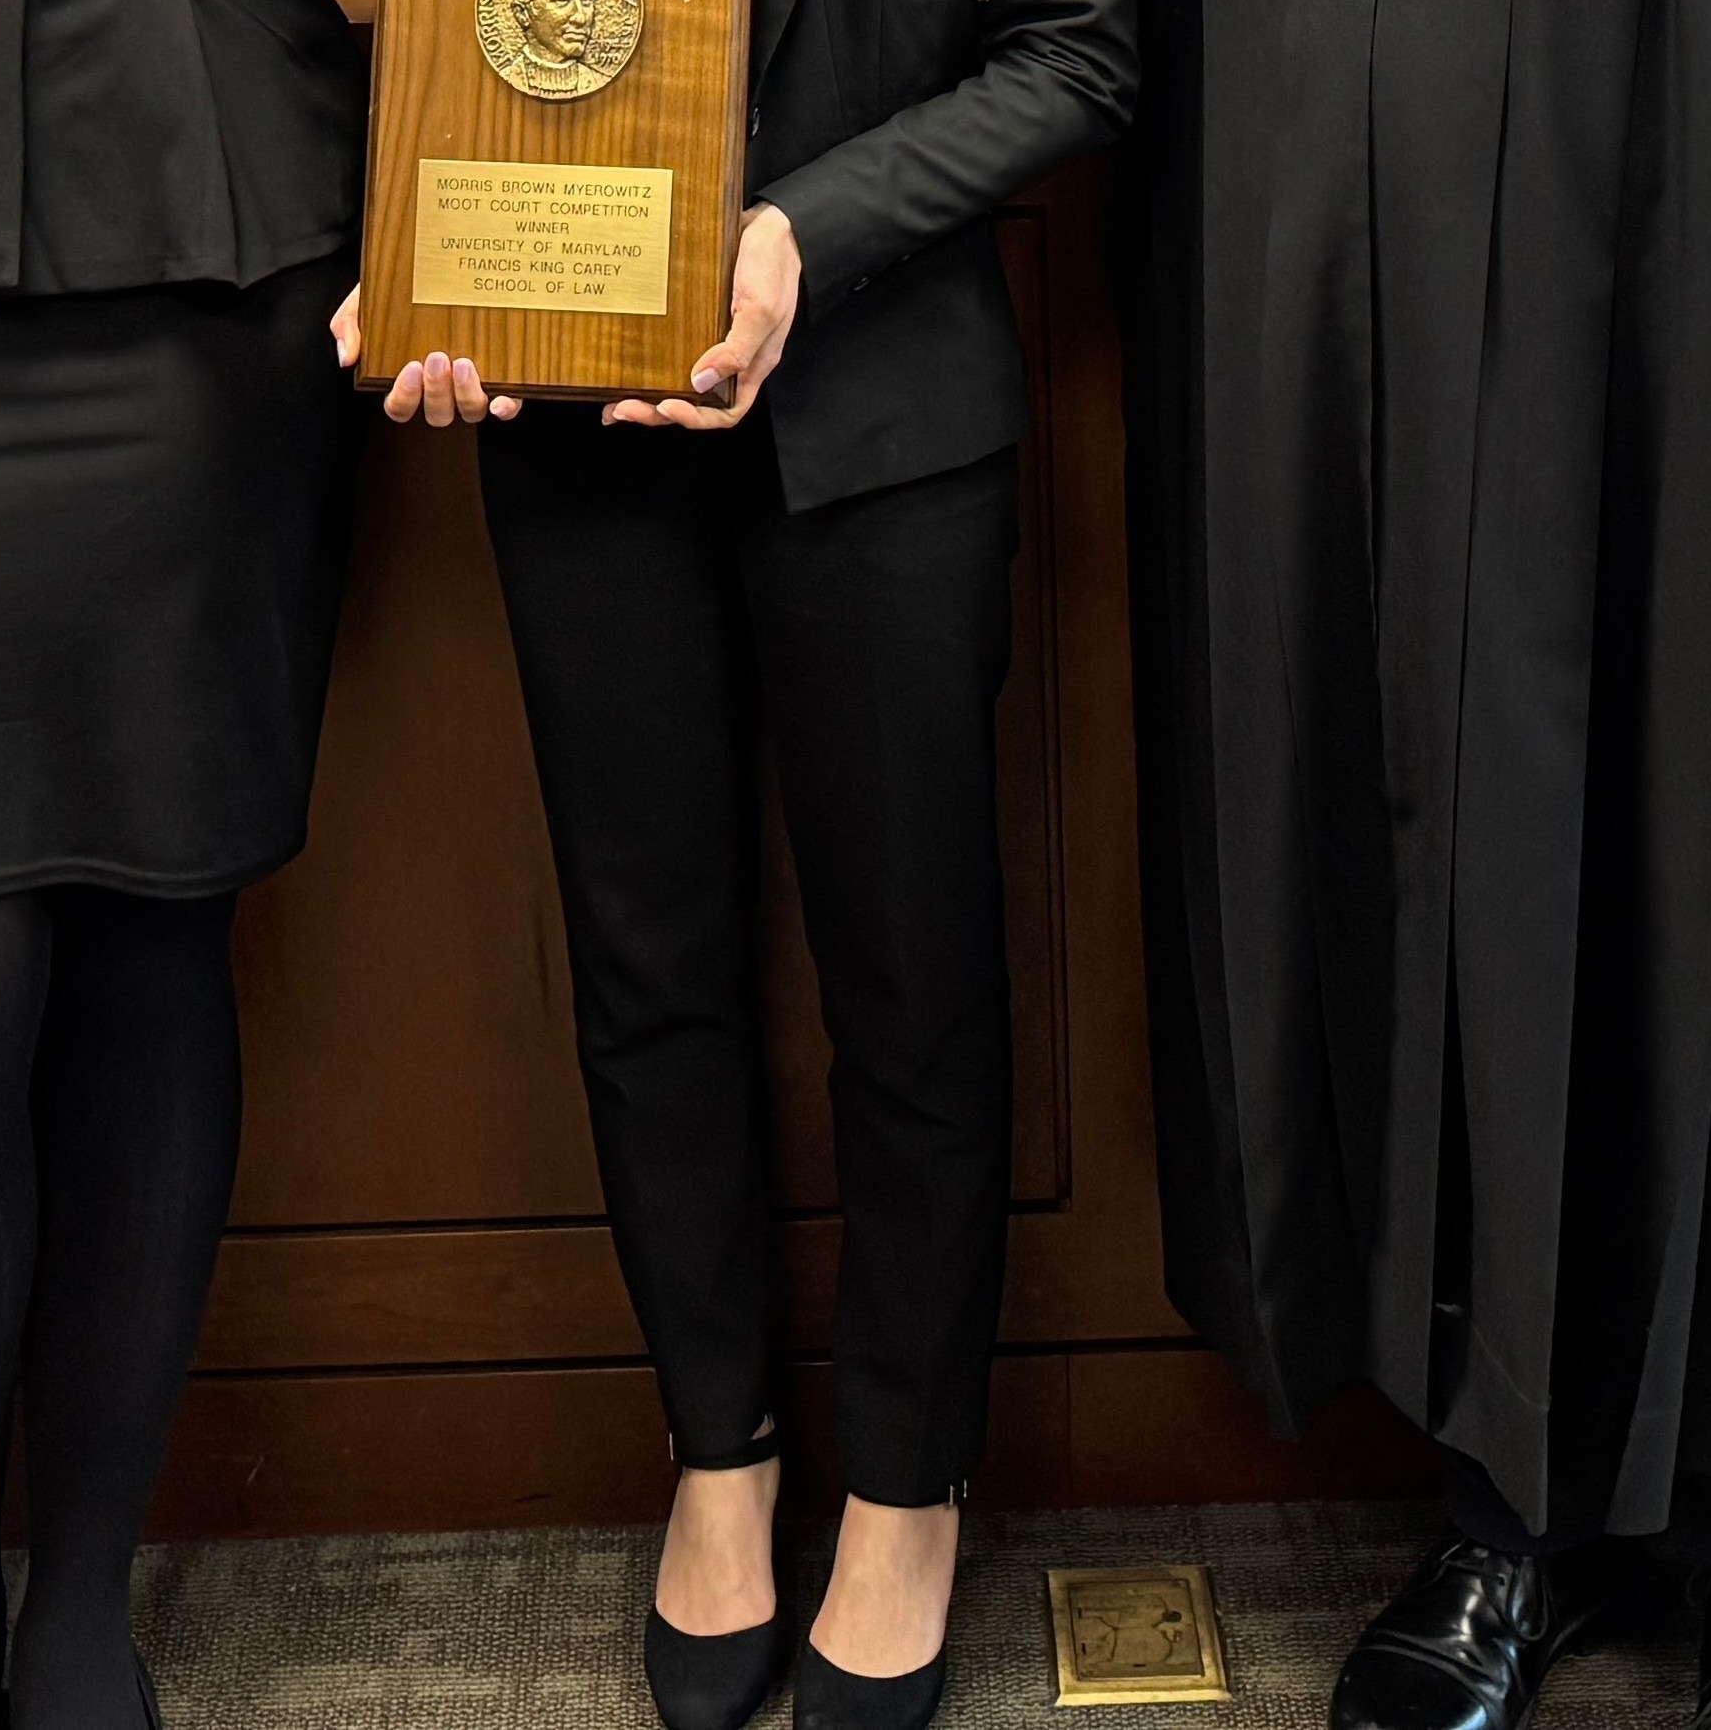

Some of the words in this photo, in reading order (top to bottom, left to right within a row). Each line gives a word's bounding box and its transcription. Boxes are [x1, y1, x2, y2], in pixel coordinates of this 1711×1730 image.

[437, 178, 493, 192] MORRIS
[502, 180, 555, 194] BROWN
[563, 183, 651, 199] MYEROWITZ
[438, 198, 481, 211] MOOT
[490, 199, 541, 213] COURT
[550, 202, 649, 218] COMPETITION
[515, 221, 570, 234] WINNER
[441, 237, 525, 252] UNIVERSITY
[533, 241, 553, 254] OF
[562, 242, 642, 257] MARYLAND
[459, 257, 521, 272] FRANCIS
[530, 260, 565, 274] KING
[573, 262, 622, 277] CAREY
[474, 277, 536, 292] SCHOOL
[546, 281, 565, 293] OF
[574, 282, 605, 295] LAW
